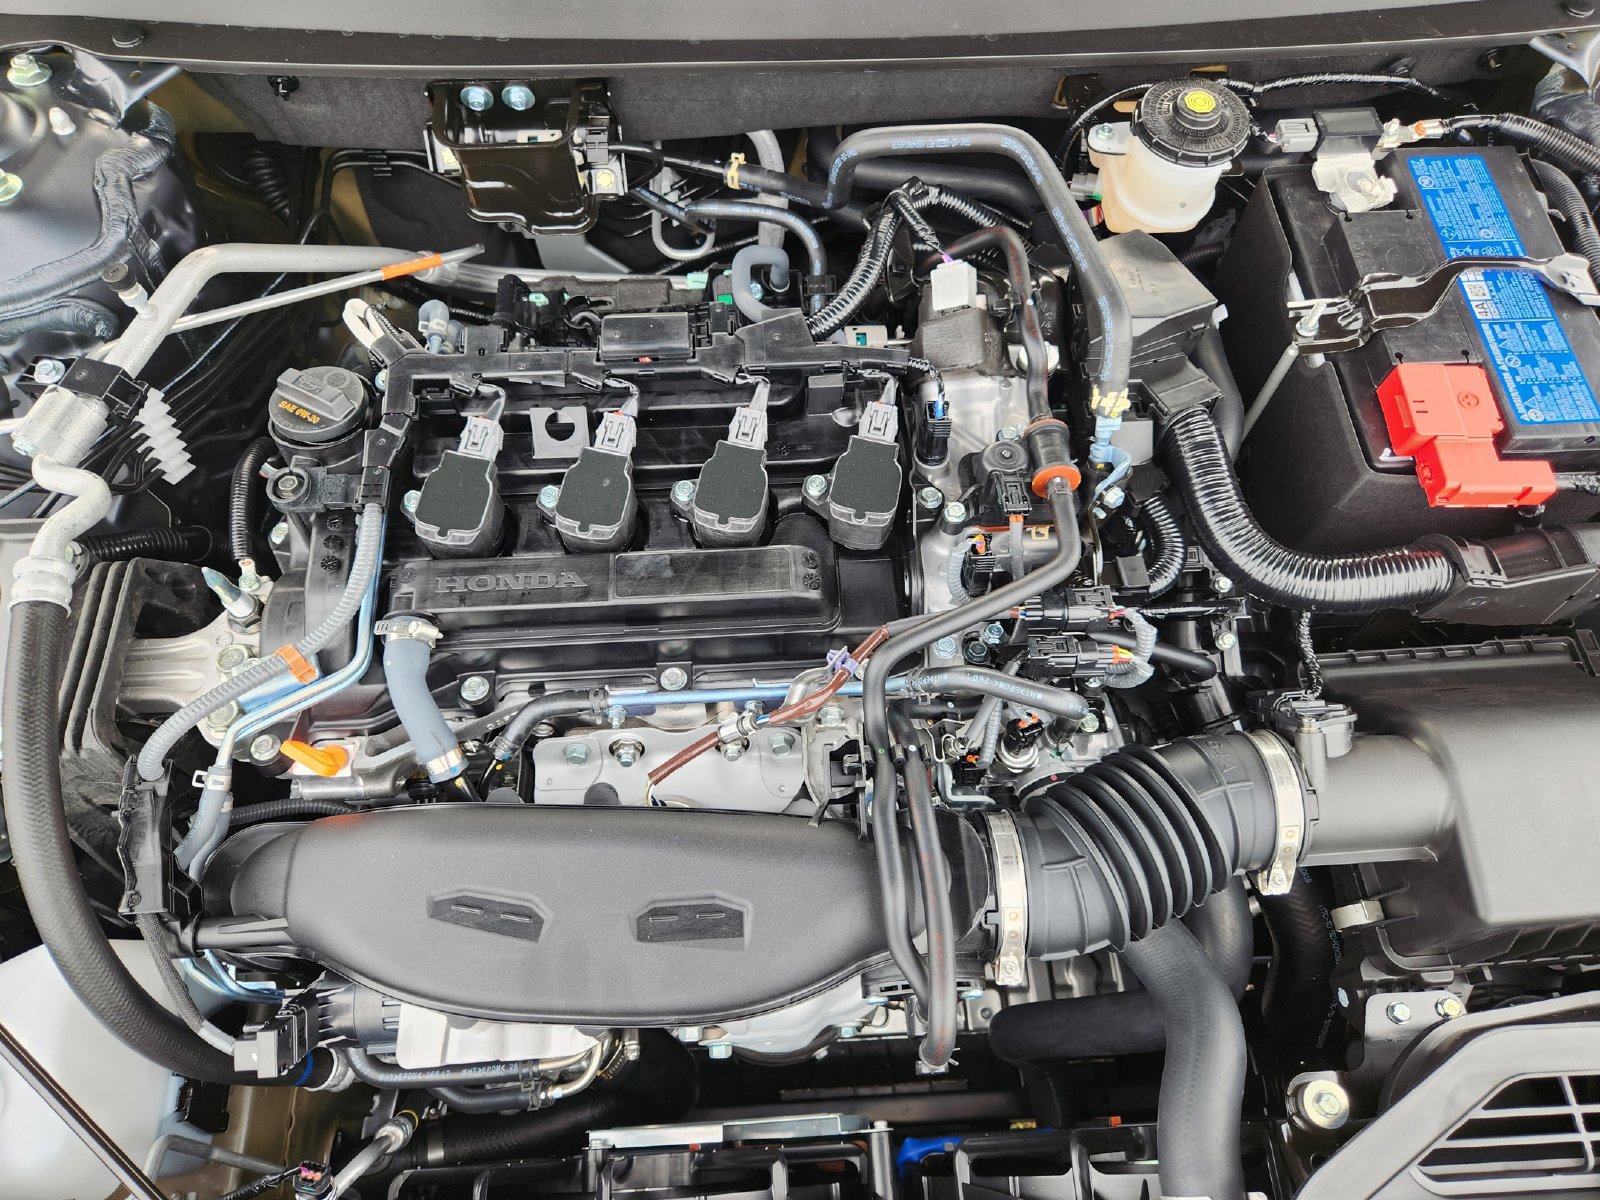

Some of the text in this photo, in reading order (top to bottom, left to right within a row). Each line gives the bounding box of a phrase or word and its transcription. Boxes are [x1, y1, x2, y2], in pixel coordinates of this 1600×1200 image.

[278, 400, 321, 424] SAE 0W-20
[435, 571, 588, 593] HONDA
